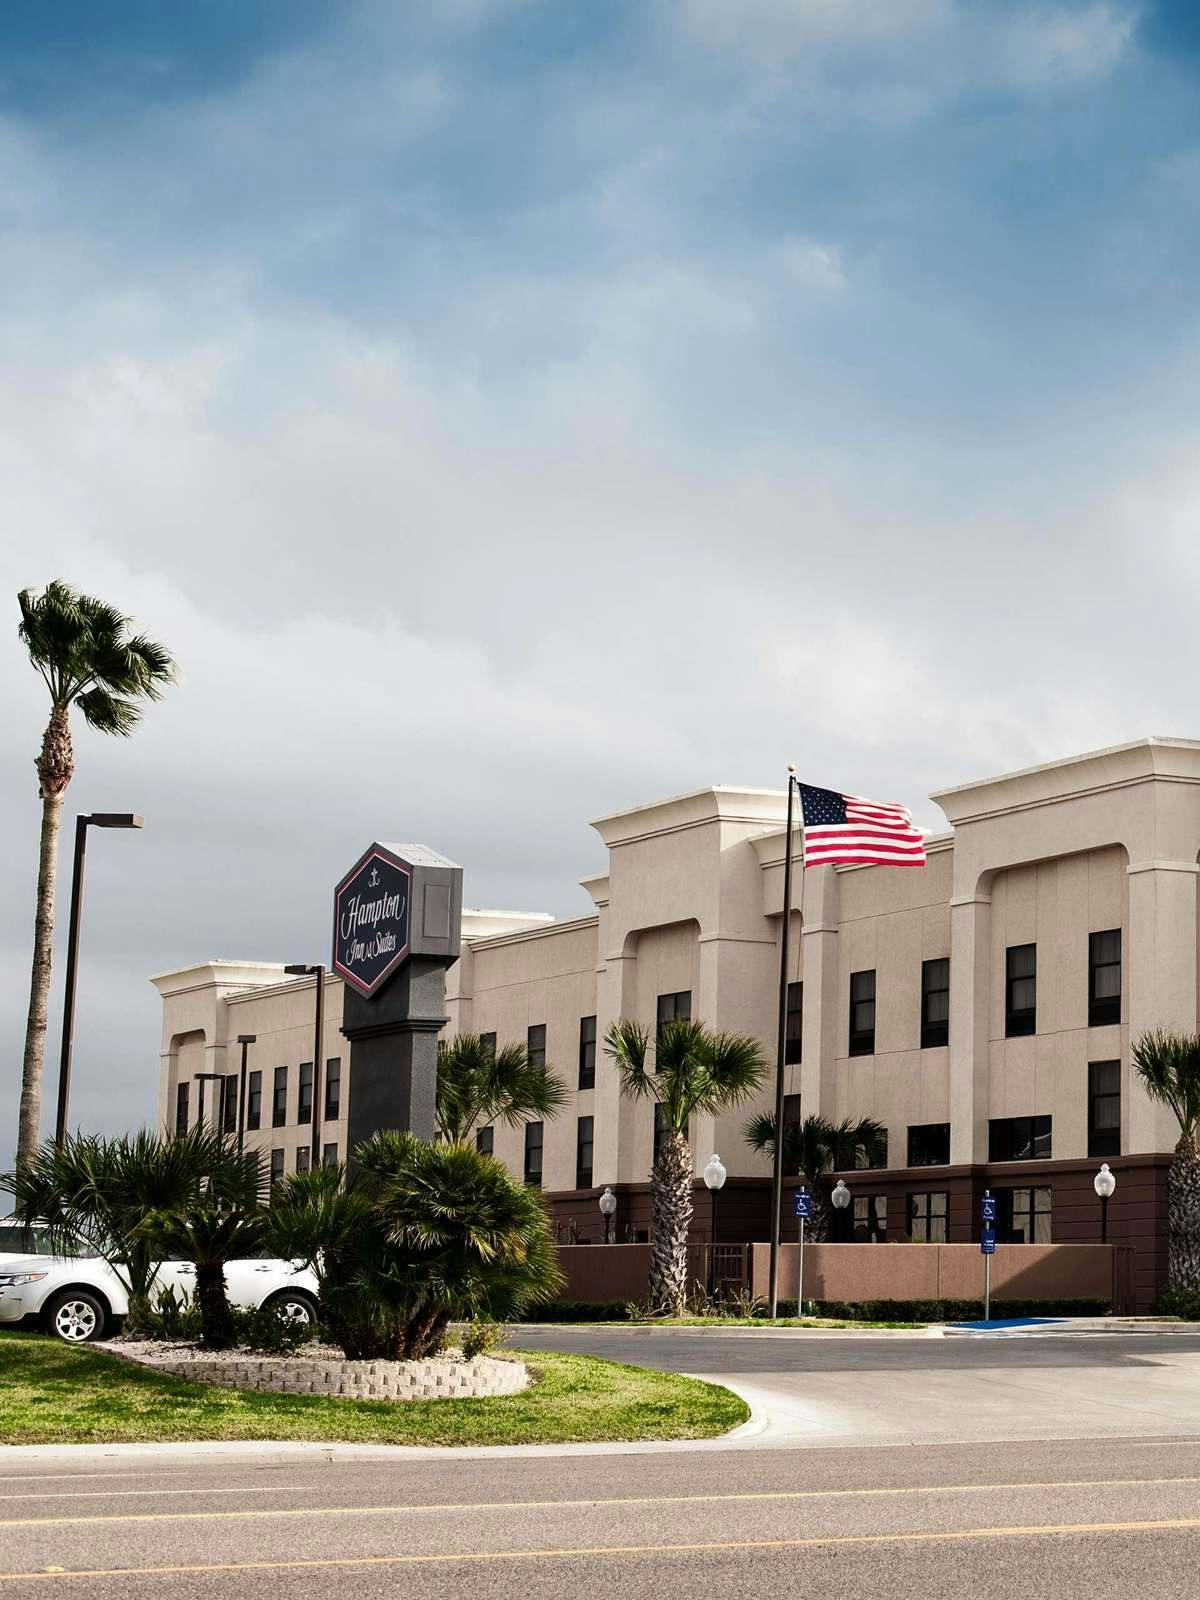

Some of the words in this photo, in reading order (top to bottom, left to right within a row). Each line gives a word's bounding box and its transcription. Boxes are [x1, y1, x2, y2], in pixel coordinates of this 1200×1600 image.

[341, 891, 406, 940] Hampton
[346, 939, 368, 965] Inn
[373, 931, 396, 957] Suites
